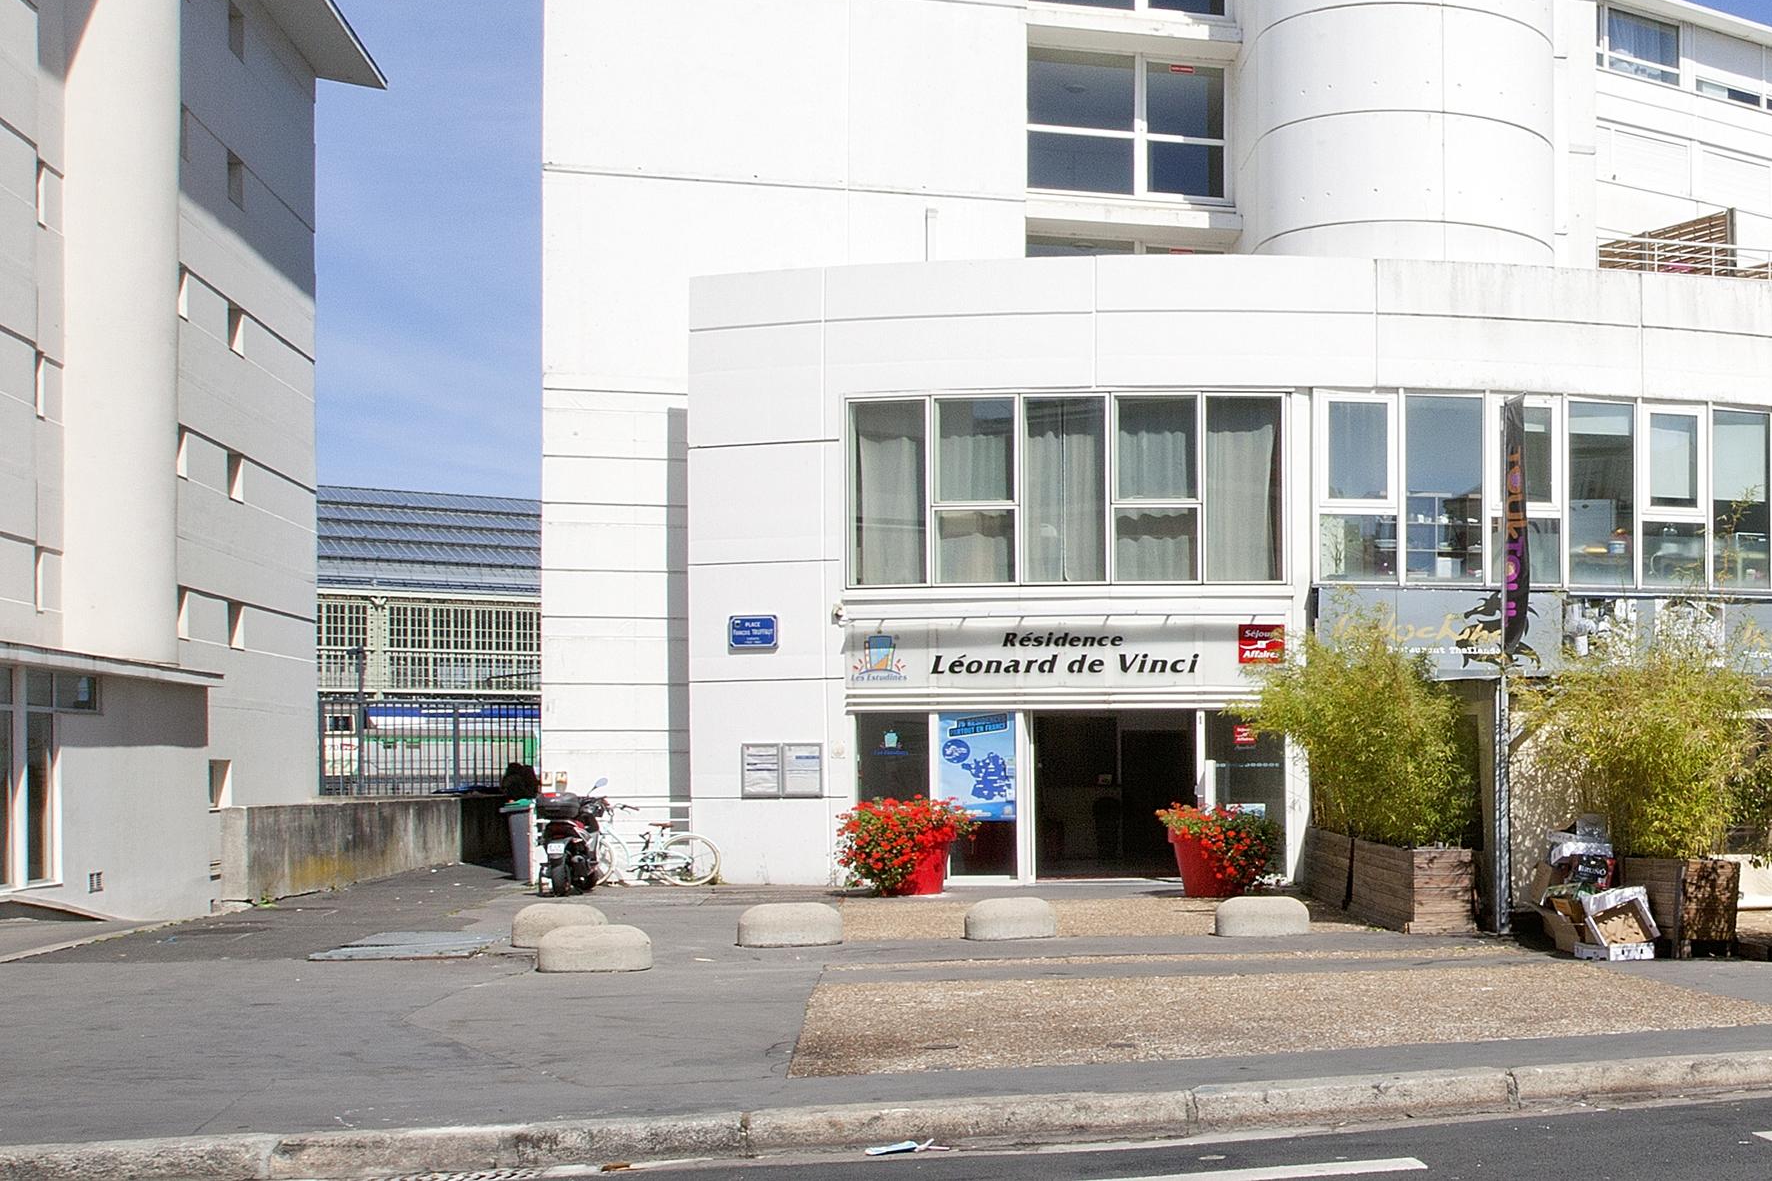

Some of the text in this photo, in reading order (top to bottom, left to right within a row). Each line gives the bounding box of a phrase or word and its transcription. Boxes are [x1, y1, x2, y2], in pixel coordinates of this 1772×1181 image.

[1002, 631, 1124, 648] Résidence
[930, 653, 1200, 675] Léonard de Vinci
[851, 673, 907, 682] Les Estudines
[1578, 864, 1607, 877] BRUNO
